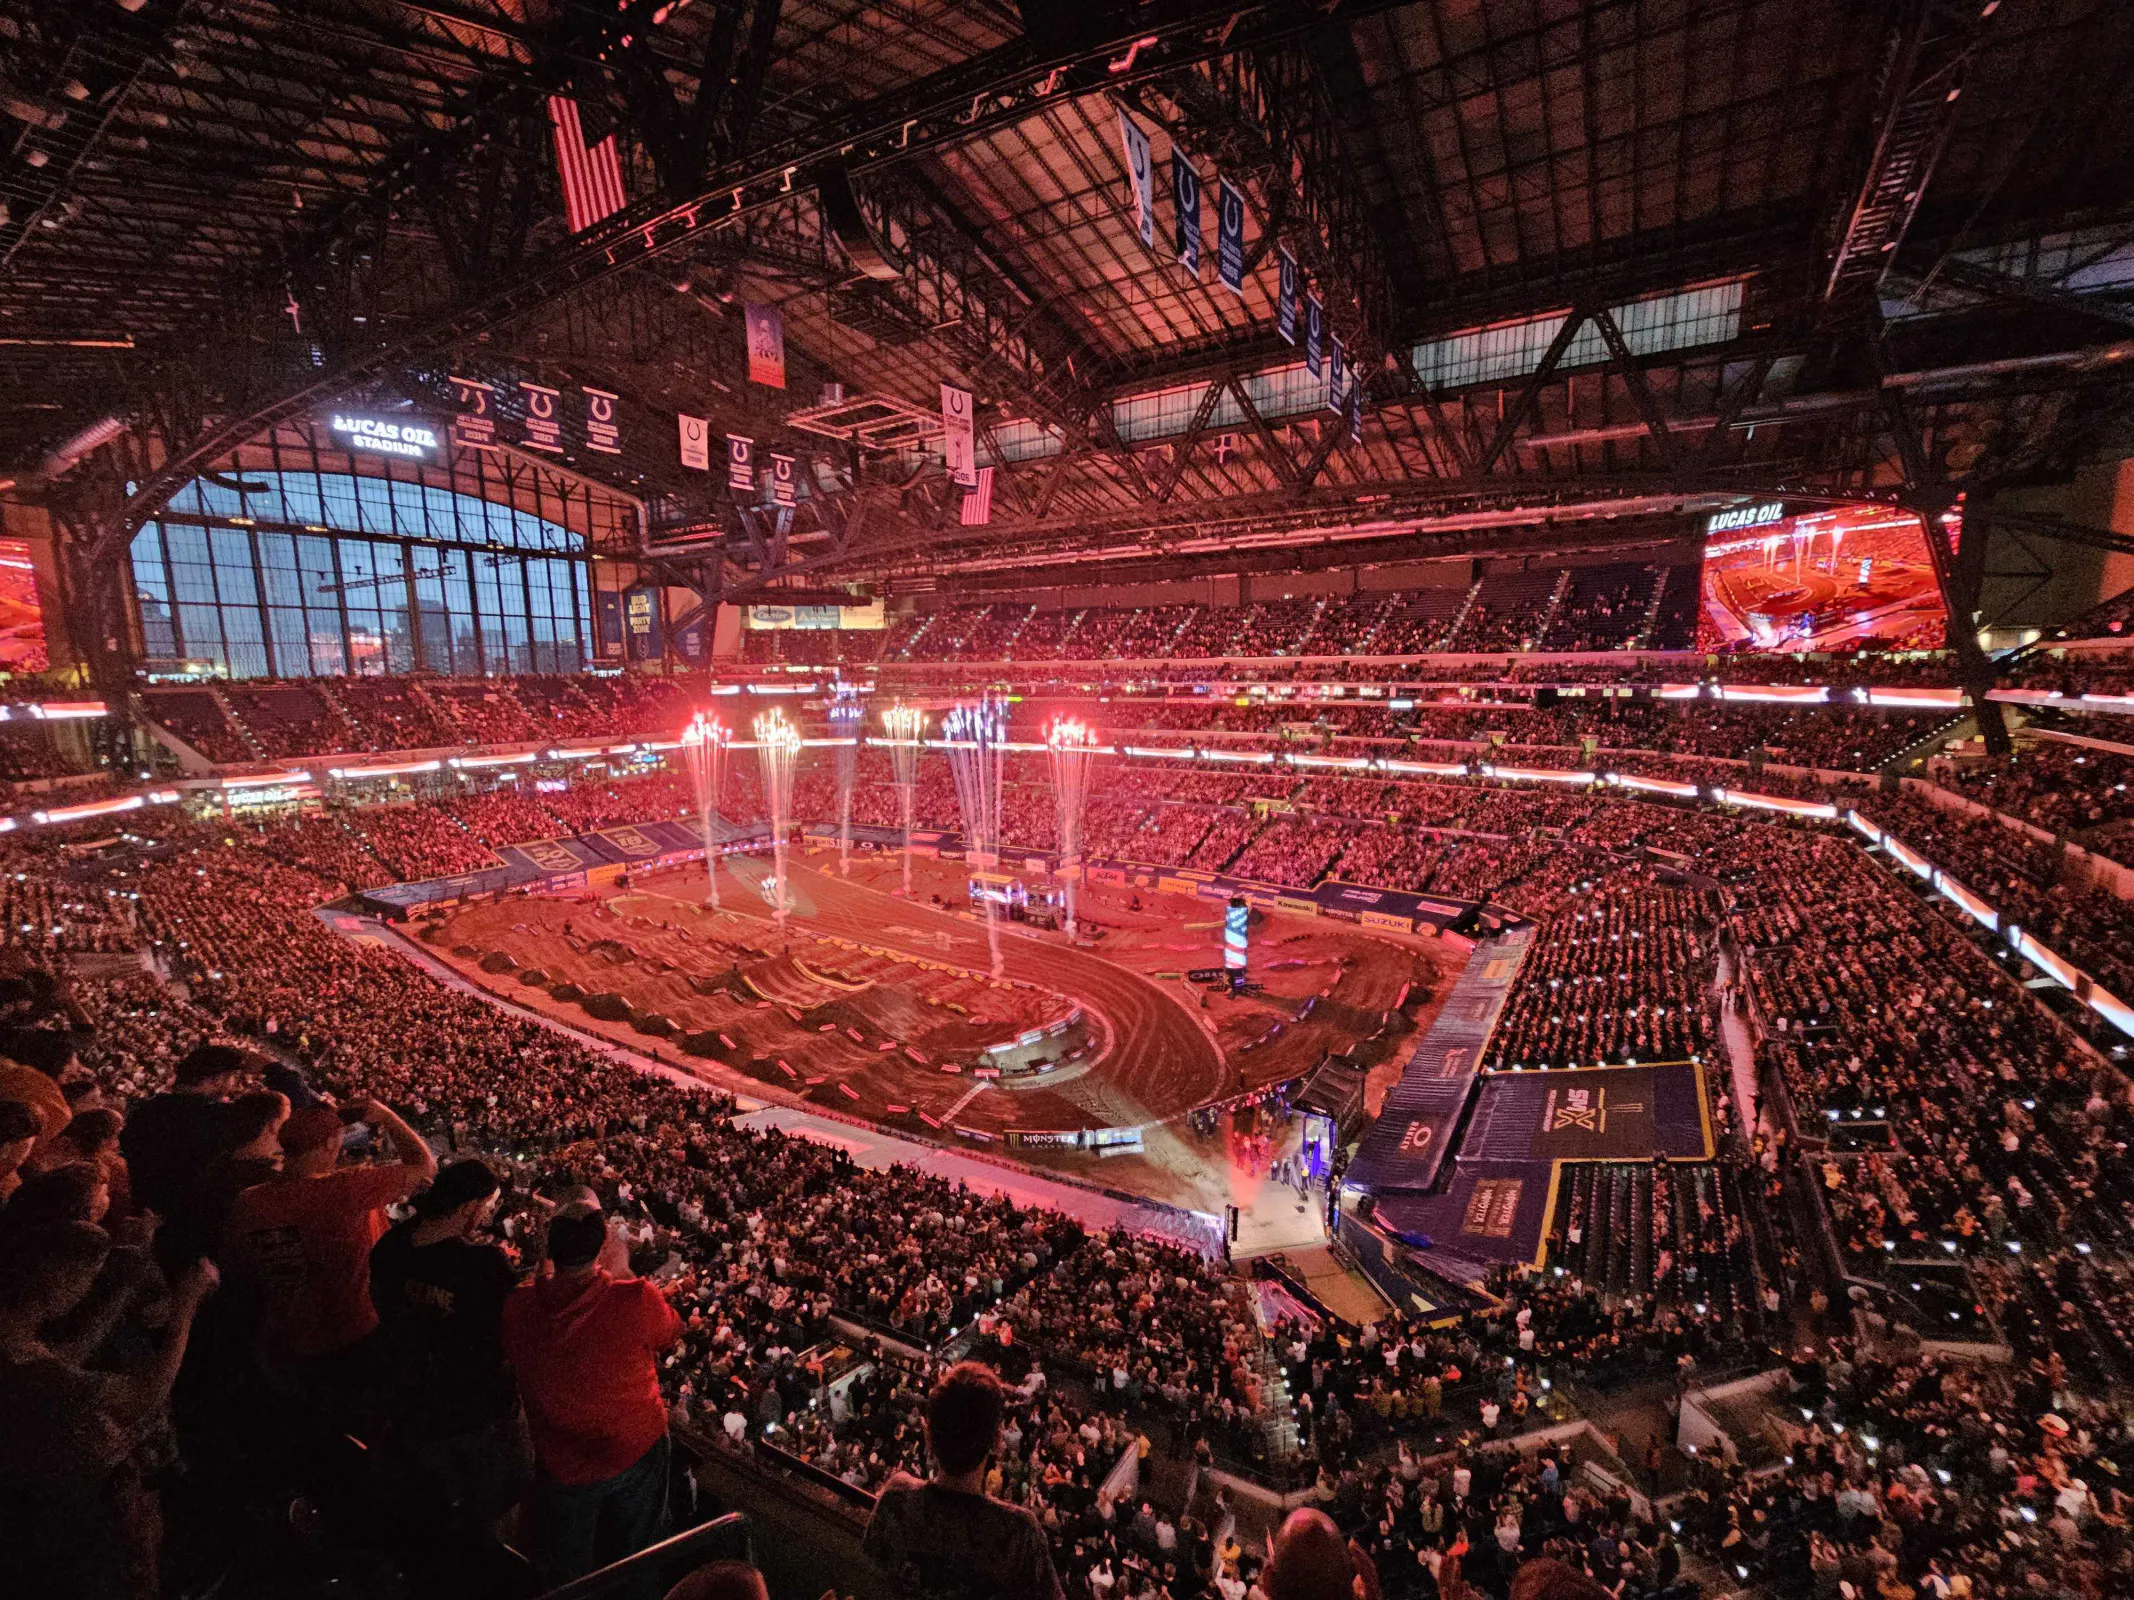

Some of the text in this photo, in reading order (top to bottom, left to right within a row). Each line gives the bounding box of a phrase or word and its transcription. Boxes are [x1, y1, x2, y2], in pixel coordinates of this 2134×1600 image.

[334, 415, 437, 447] LUCAS OIL
[353, 434, 423, 456] STADIUM
[1708, 503, 1783, 530] LUCAS OIL
[1277, 900, 1314, 912] Kawasaki
[1363, 916, 1411, 929] SUZUKI
[1553, 1088, 1597, 1132] SMX
[1023, 1133, 1074, 1144] MONSTER
[1401, 1120, 1420, 1150] OAKLEY
[1473, 1189, 1494, 1223] MONSTER
[1498, 1189, 1518, 1225] MONSTER
